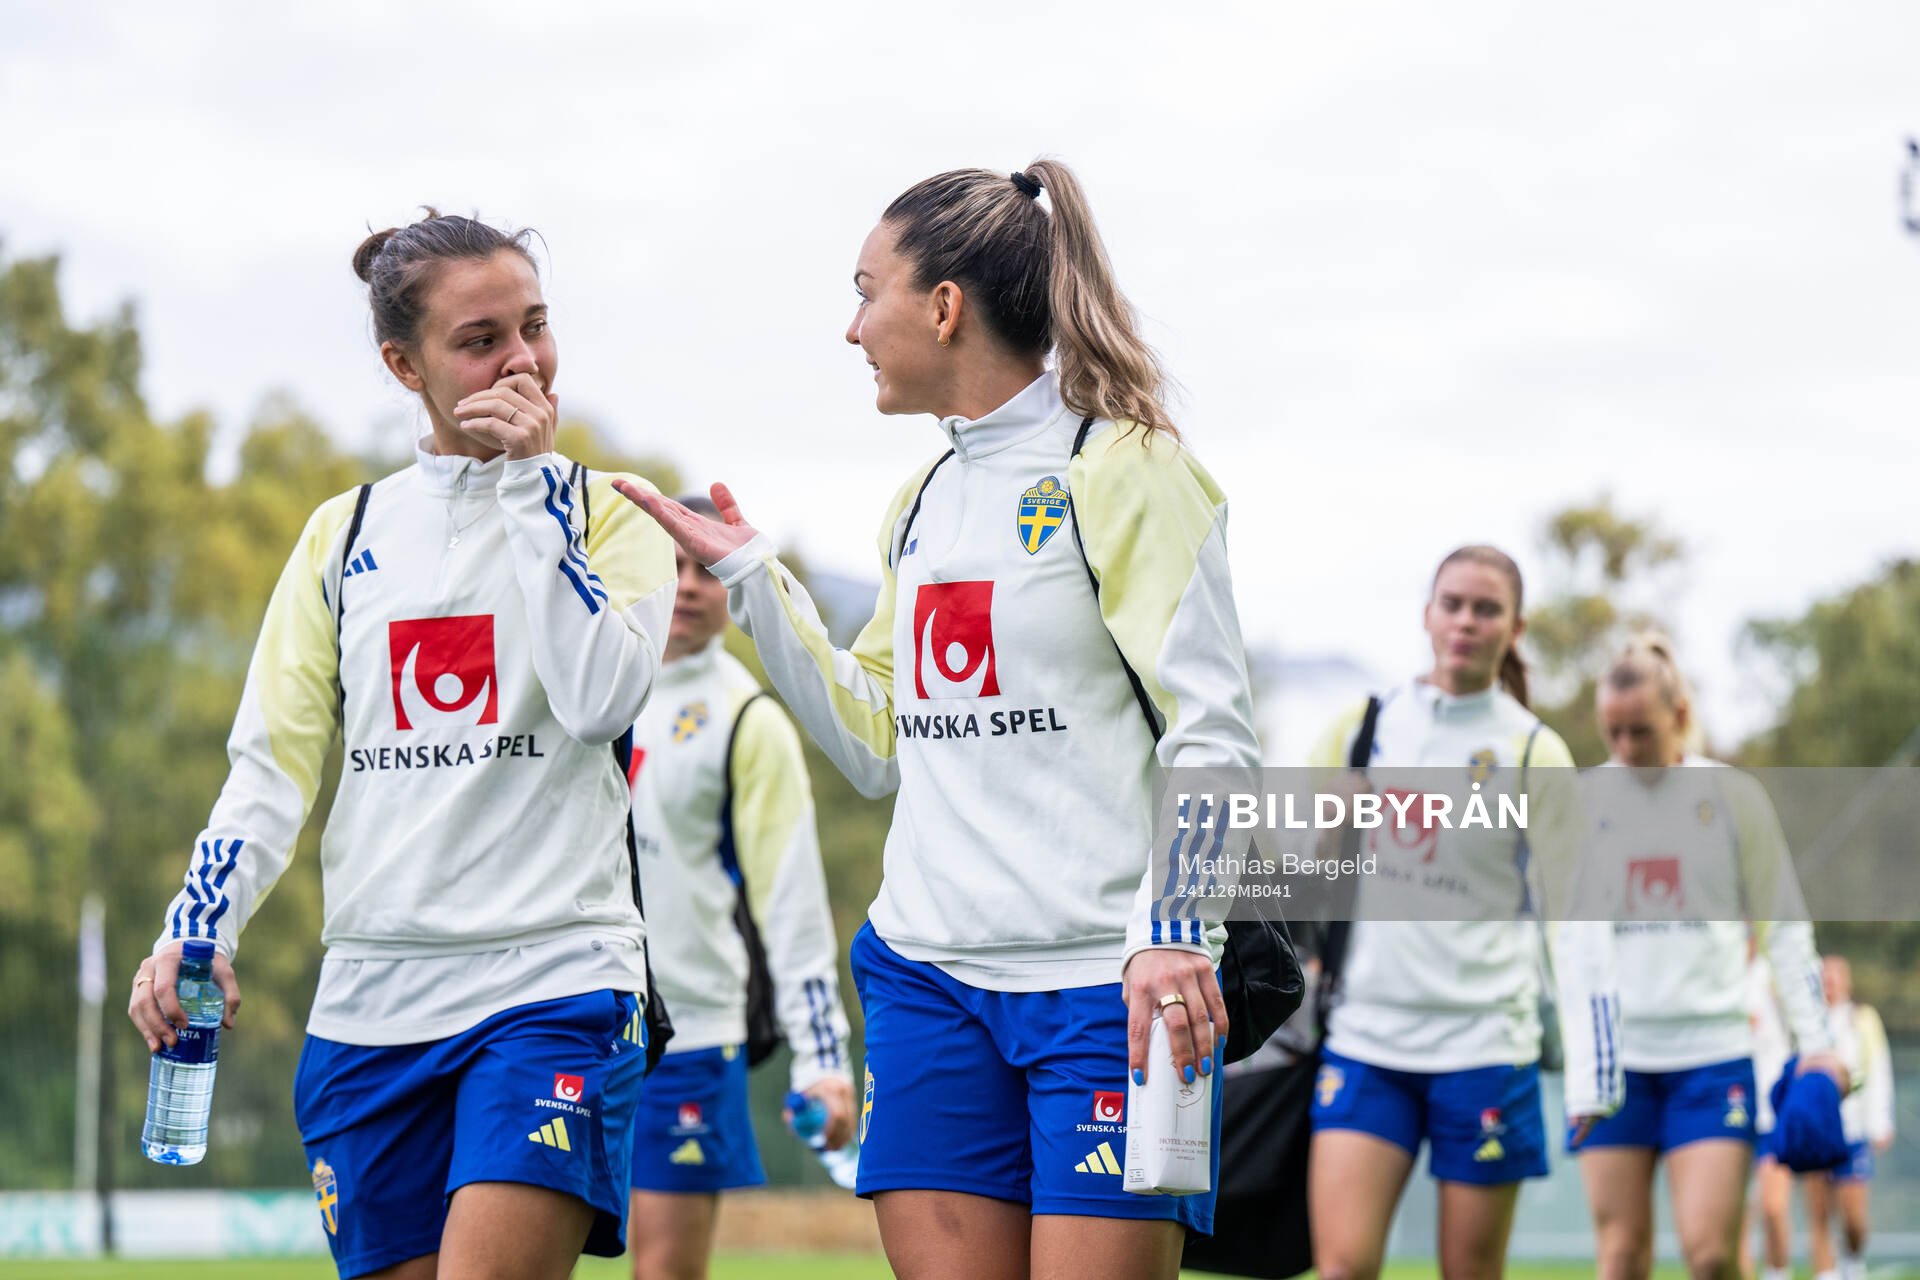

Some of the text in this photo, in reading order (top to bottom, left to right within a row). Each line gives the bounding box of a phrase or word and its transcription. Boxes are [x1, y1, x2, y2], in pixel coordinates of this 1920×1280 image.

[1027, 498, 1062, 506] SVERIGE
[990, 707, 1067, 737] SPEL
[350, 734, 544, 772] SVENSKA SPEL
[535, 1098, 592, 1118] SVENSKA SPEL
[1076, 1124, 1116, 1133] SVENSKA
